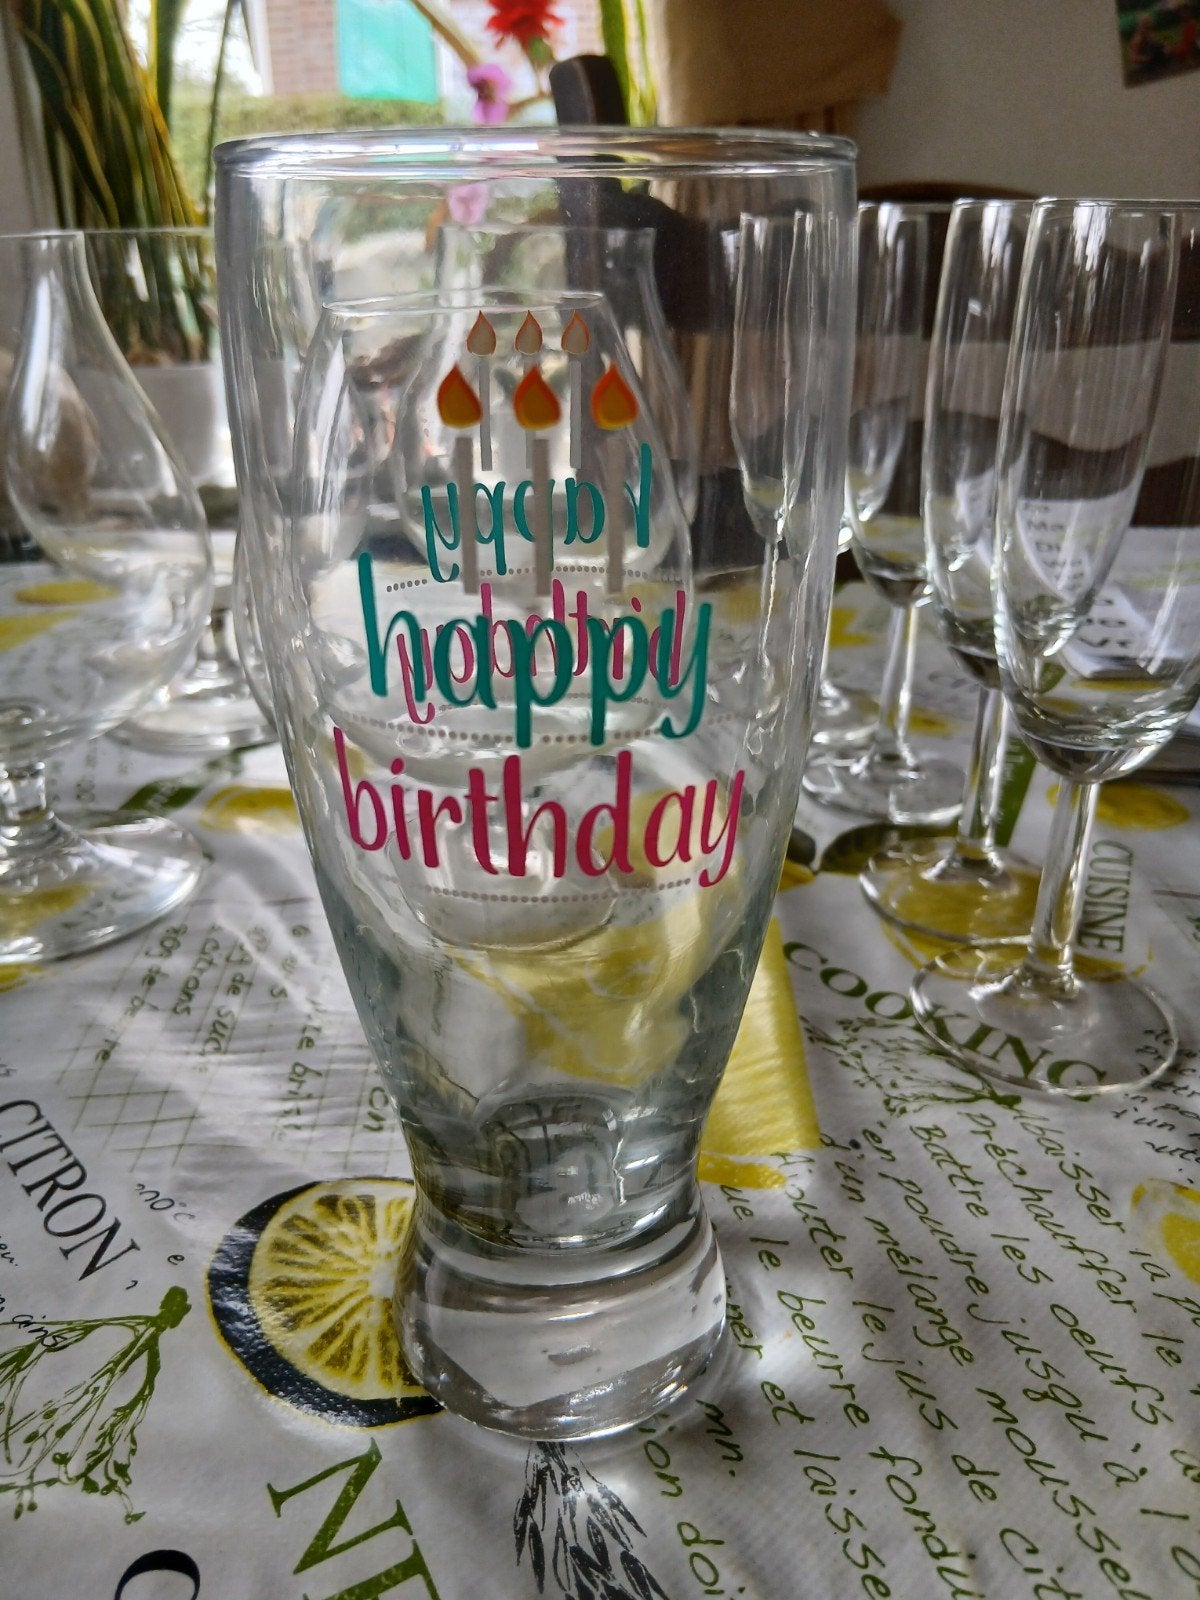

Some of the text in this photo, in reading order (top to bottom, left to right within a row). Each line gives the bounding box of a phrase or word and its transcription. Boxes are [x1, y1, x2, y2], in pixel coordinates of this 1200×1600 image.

[358, 552, 712, 749] happy
[333, 727, 744, 887] birthday
[1077, 838, 1133, 954] CUISINE
[783, 940, 1108, 1101] COOKING
[0, 1099, 141, 1281] CITRON
[878, 1171, 990, 1296] poudre
[719, 1183, 754, 1221] ue
[749, 1236, 790, 1271] le
[777, 1289, 870, 1428] beurre
[852, 1300, 895, 1334] le
[909, 1124, 1175, 1424] Battre les oeufs
[761, 1381, 815, 1425] et
[820, 1133, 1153, 1600] d'un mélange mousse
[861, 1340, 959, 1430] jus
[1141, 1331, 1184, 1368] le
[952, 1454, 1000, 1503] de
